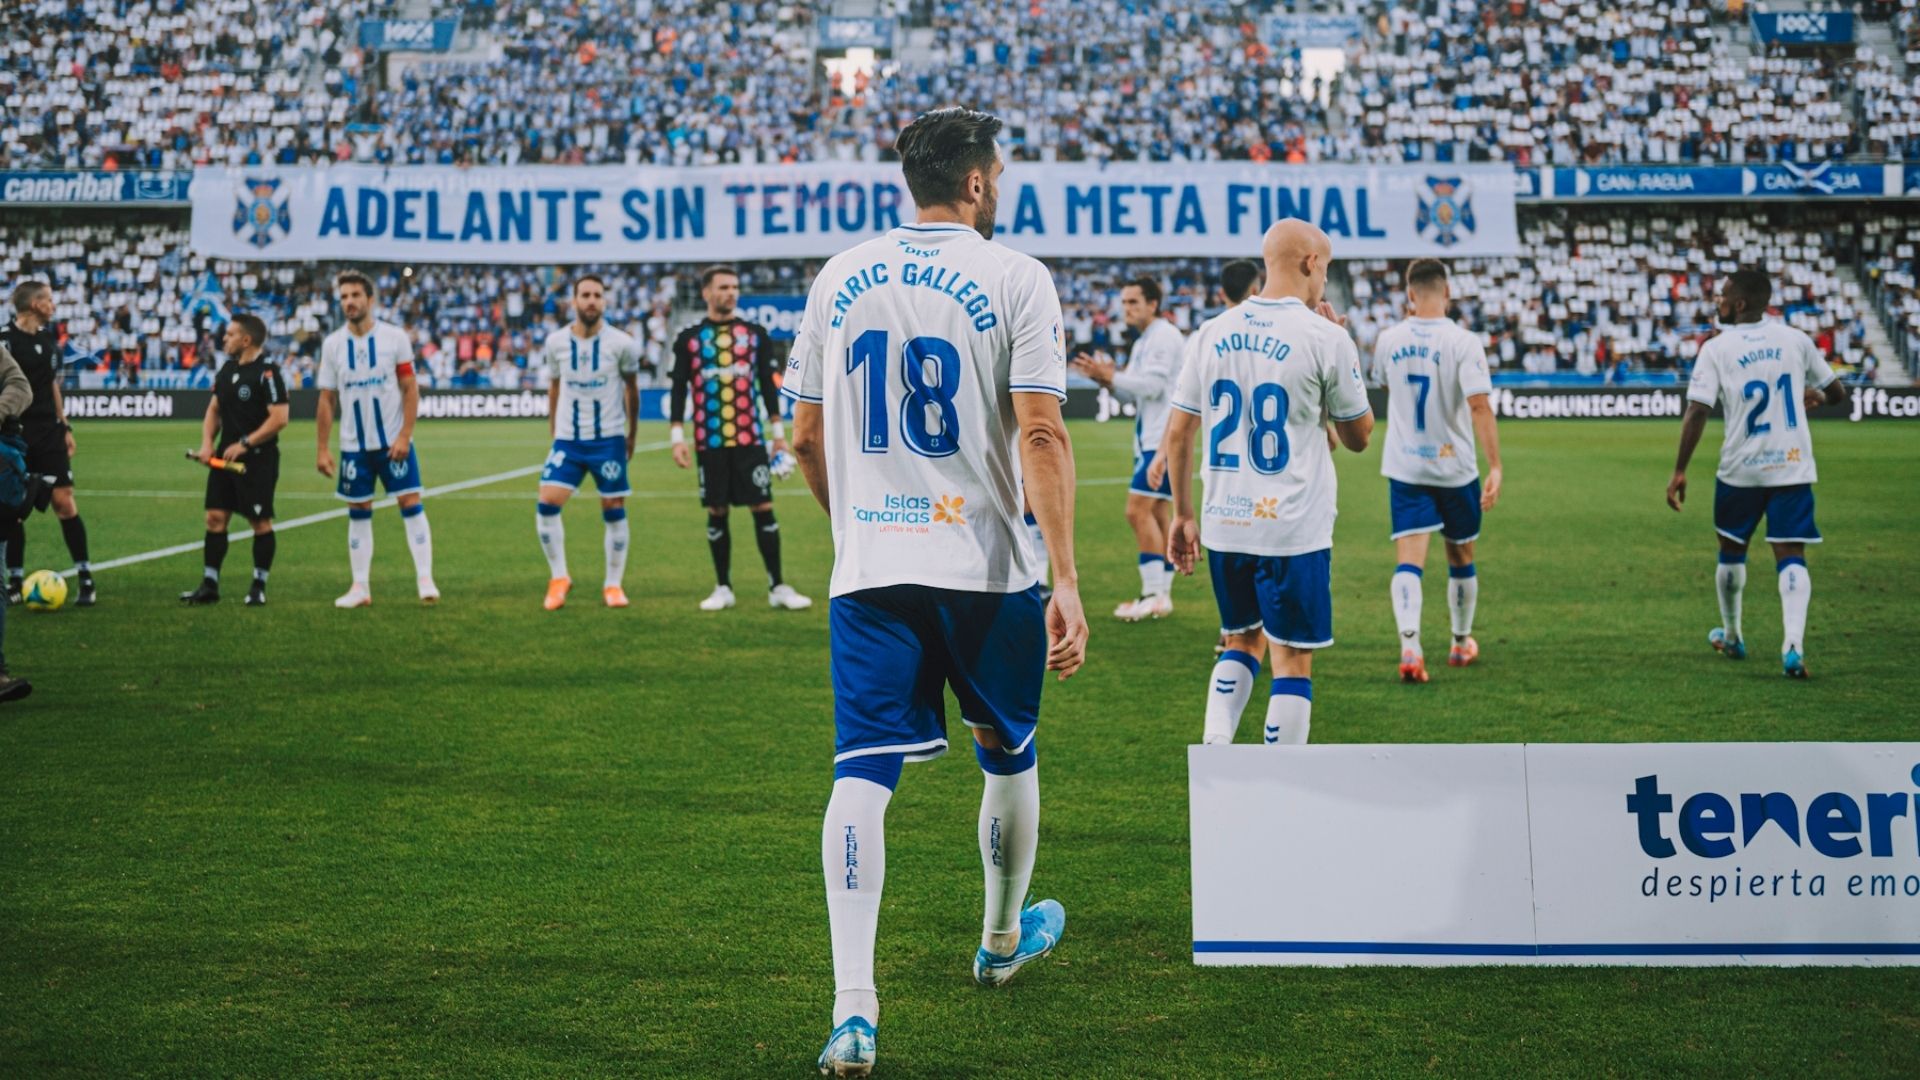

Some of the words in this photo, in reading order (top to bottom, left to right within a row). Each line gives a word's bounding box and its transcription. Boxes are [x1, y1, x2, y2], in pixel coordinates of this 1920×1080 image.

[4, 172, 125, 201] canaribat
[318, 186, 601, 242] ADELANTE
[621, 185, 706, 241] SIN
[725, 181, 902, 236] TEMOR
[1066, 184, 1208, 235] META
[1227, 184, 1387, 238] FINAL
[831, 263, 890, 329] ENRIC
[901, 263, 998, 333] GALLEGO
[1215, 333, 1291, 362] MOLLEJO
[1738, 347, 1783, 369] MOORE
[846, 329, 961, 458] 18
[1406, 374, 1430, 433] 7
[1743, 373, 1798, 438] 21
[1208, 378, 1290, 476] 28
[853, 506, 930, 524] anarias
[885, 494, 931, 510] Islas
[1640, 866, 1826, 903] despierta
[1847, 874, 1920, 897] emo
